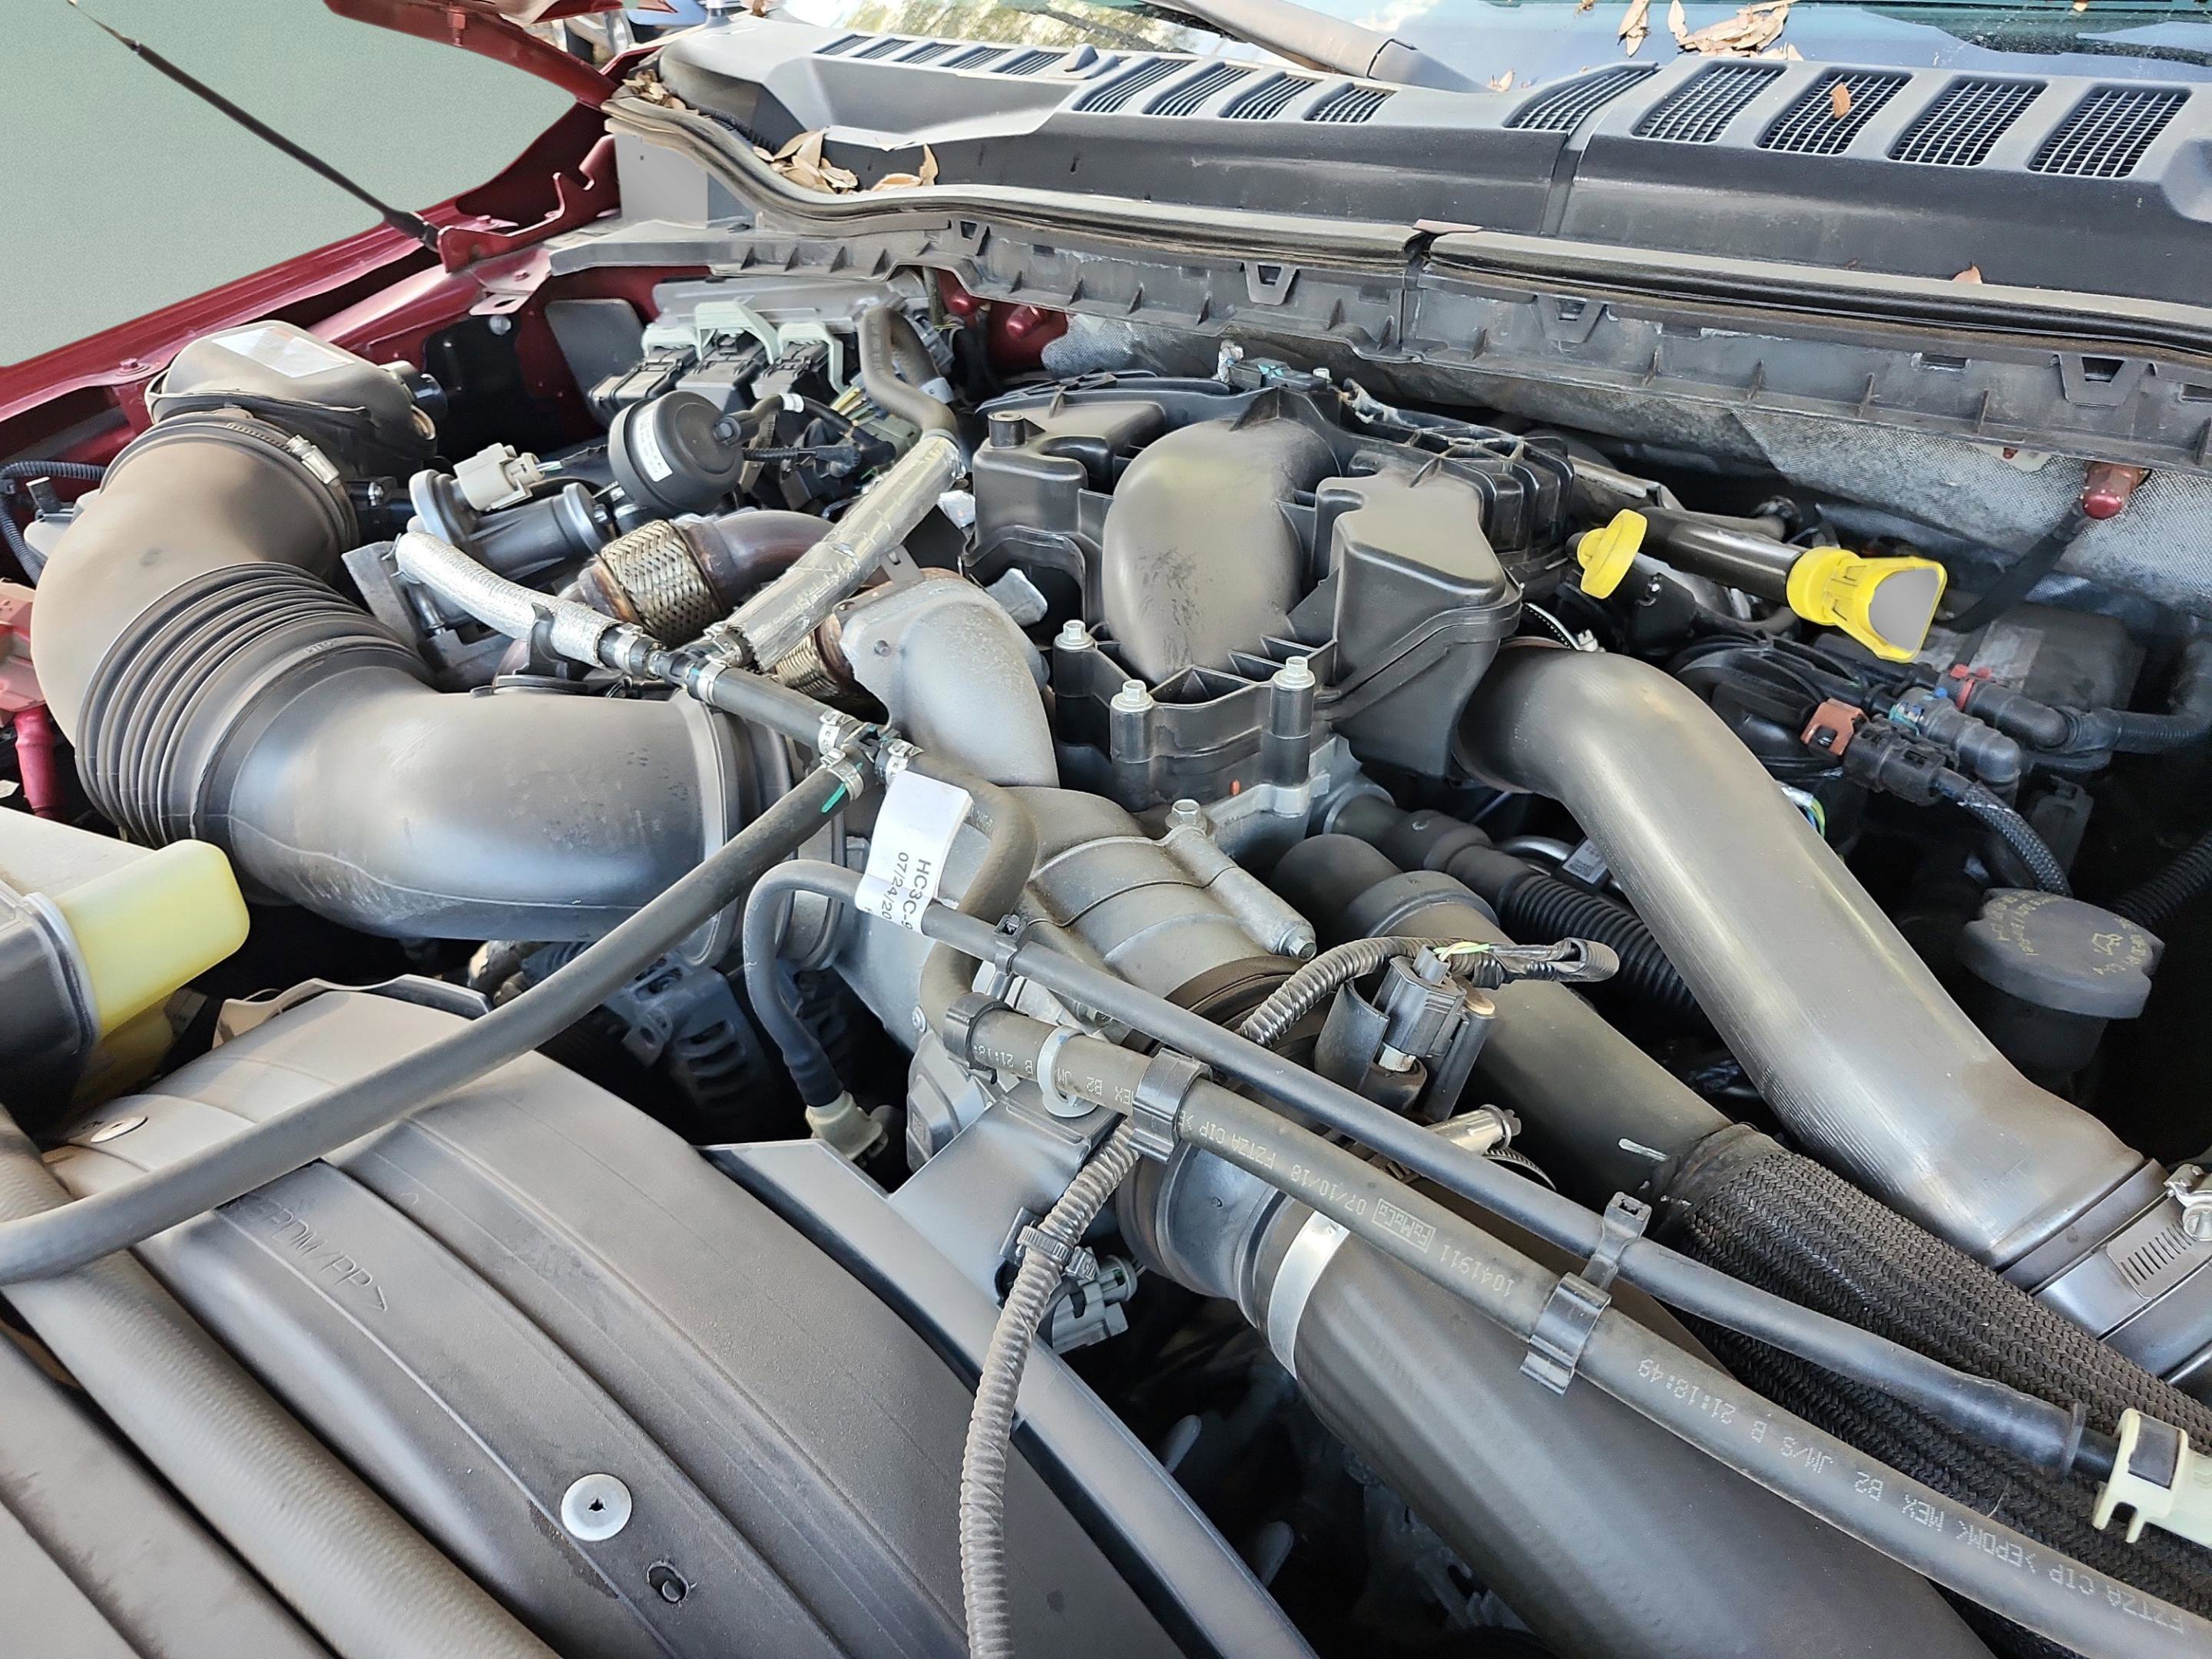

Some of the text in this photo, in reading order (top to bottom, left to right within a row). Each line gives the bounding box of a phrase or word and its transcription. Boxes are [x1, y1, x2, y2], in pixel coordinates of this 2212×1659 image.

[882, 852, 909, 919] 07/24/20
[1025, 1059, 1033, 1075] B
[1087, 1076, 1103, 1096] B2
[1199, 1121, 1225, 1144] CIP
[1290, 1164, 1367, 1215] 07/10/18
[1440, 1244, 1515, 1296] 1041911
[1637, 1358, 1736, 1424] 21:18:49
[1751, 1421, 1767, 1442] B
[1781, 1436, 1833, 1473] JM/S
[1854, 1471, 1883, 1501] B2
[1902, 1495, 1944, 1531] MEX
[2049, 1565, 2094, 1595] CIP
